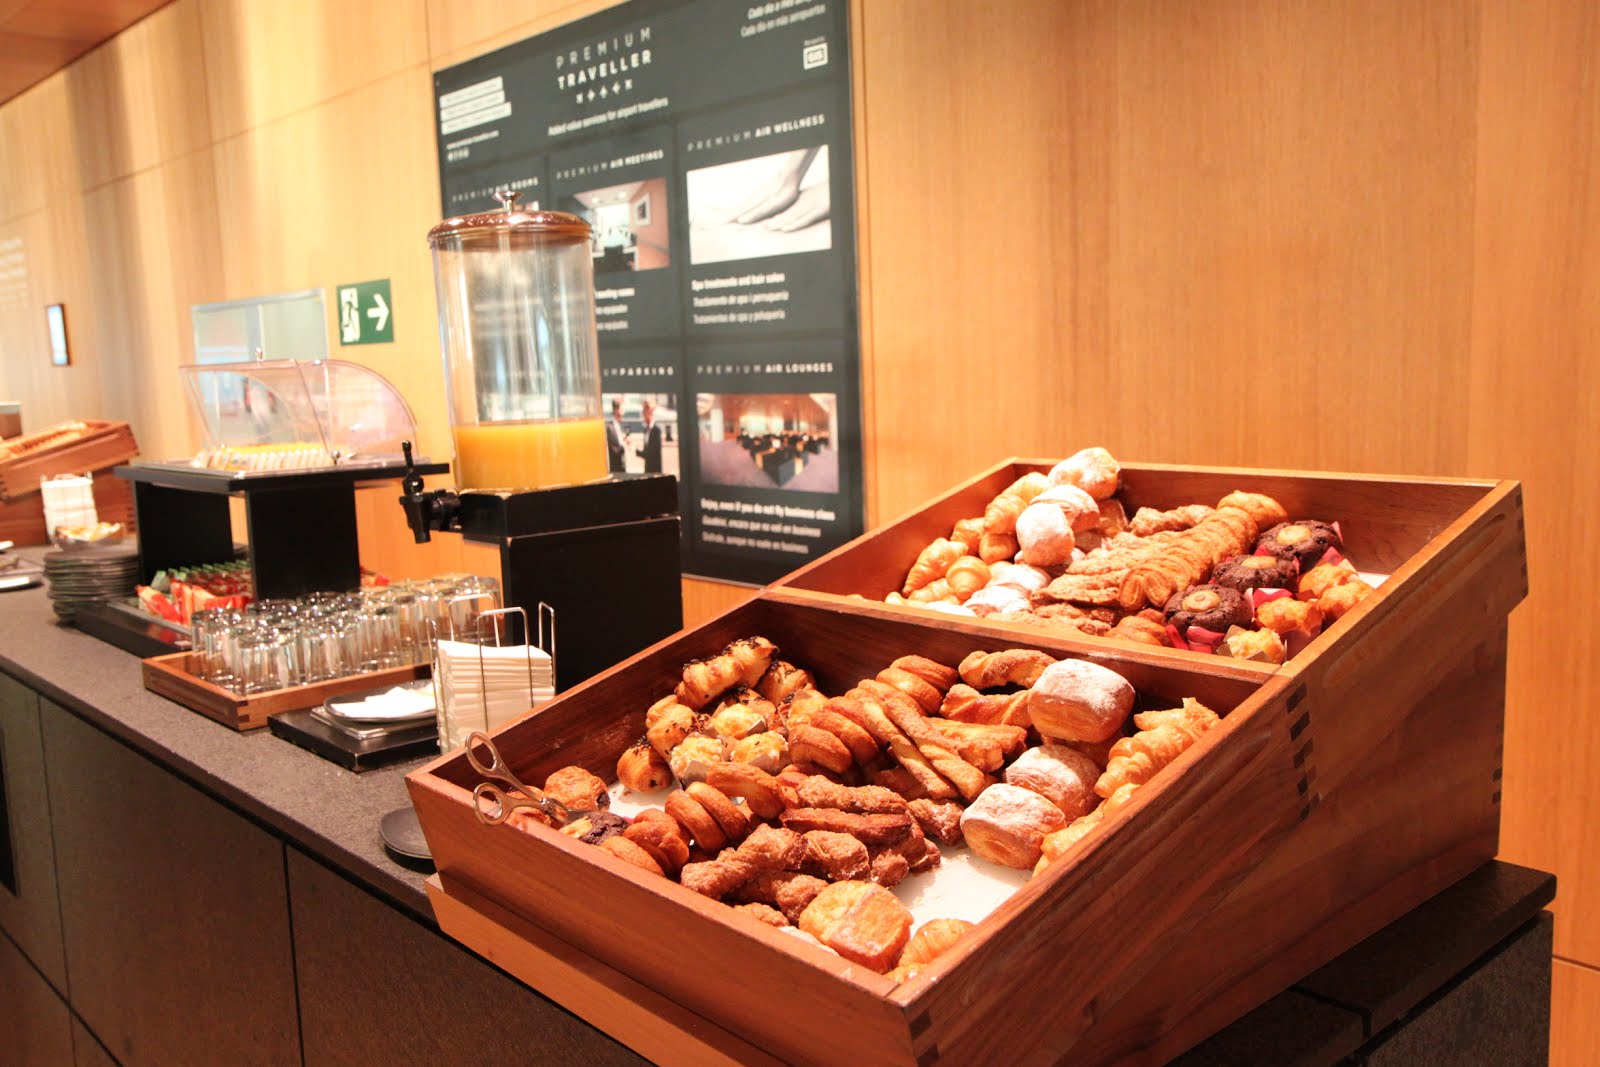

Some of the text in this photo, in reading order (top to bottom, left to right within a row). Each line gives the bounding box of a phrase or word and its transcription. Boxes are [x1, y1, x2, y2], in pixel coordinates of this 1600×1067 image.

[556, 26, 651, 70] PREMIUM
[557, 49, 652, 90] TRAVELLER
[687, 113, 825, 152] PREMIUM AIR WELLNESS
[609, 158, 624, 169] AIR
[624, 149, 664, 166] MEETINGS
[619, 366, 674, 377] PARKING
[697, 362, 834, 375] PREMIUM AIR LOUNGES
